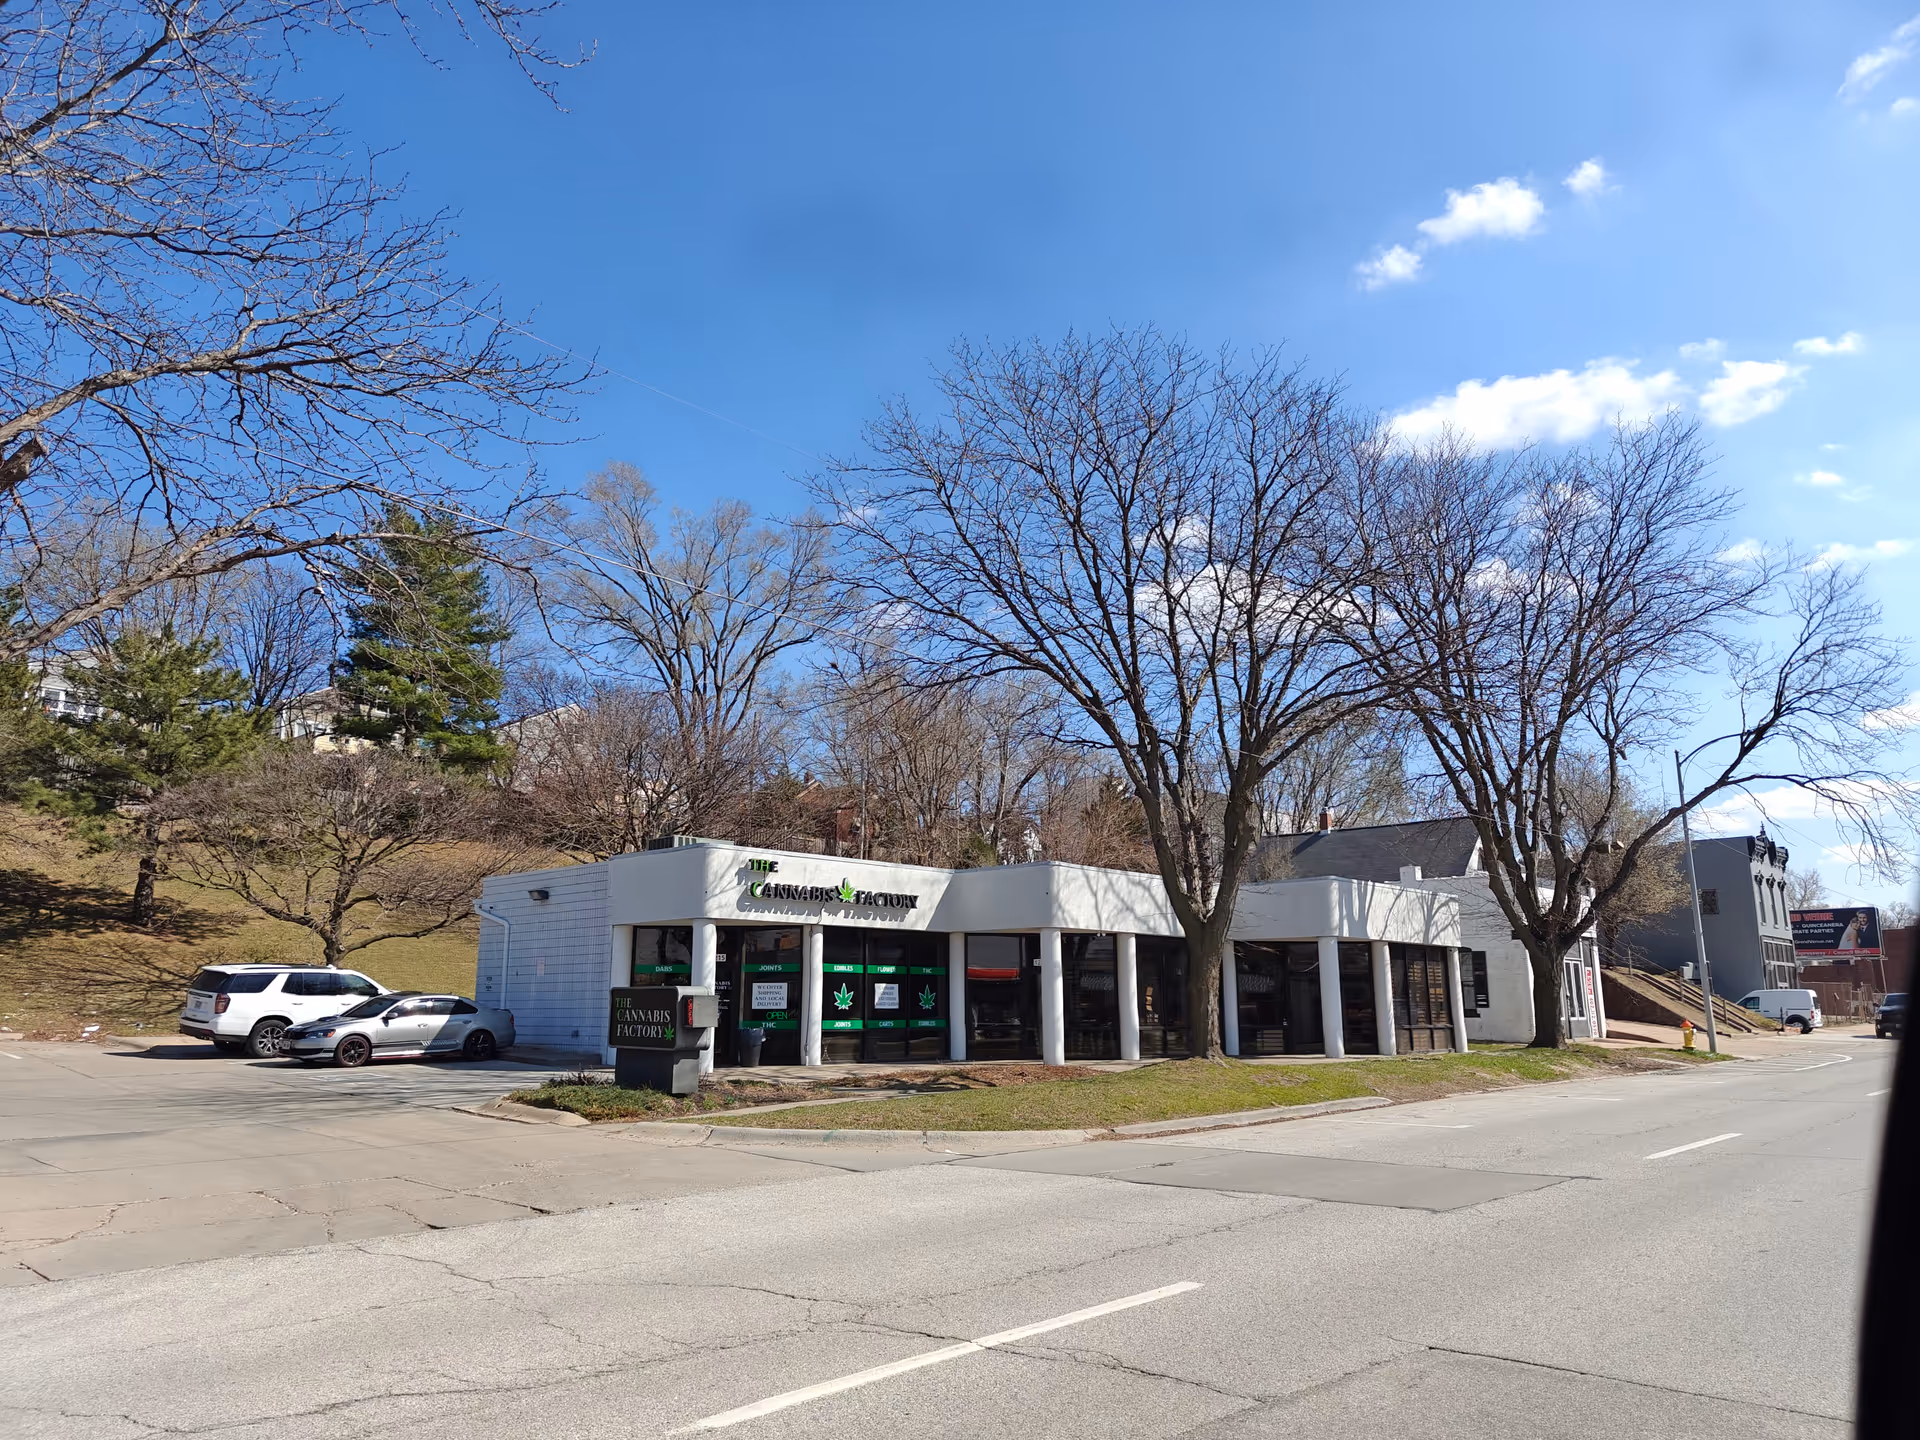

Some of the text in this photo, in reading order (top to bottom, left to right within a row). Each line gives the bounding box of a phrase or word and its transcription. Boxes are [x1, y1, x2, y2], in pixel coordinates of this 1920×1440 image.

[749, 858, 779, 873] THE
[751, 881, 919, 909] CANNABIS FACTORY
[616, 998, 632, 1008] THE
[617, 1009, 671, 1023] CANNABIS
[766, 1011, 788, 1020] OPEN
[617, 1024, 664, 1038] FACTORY
